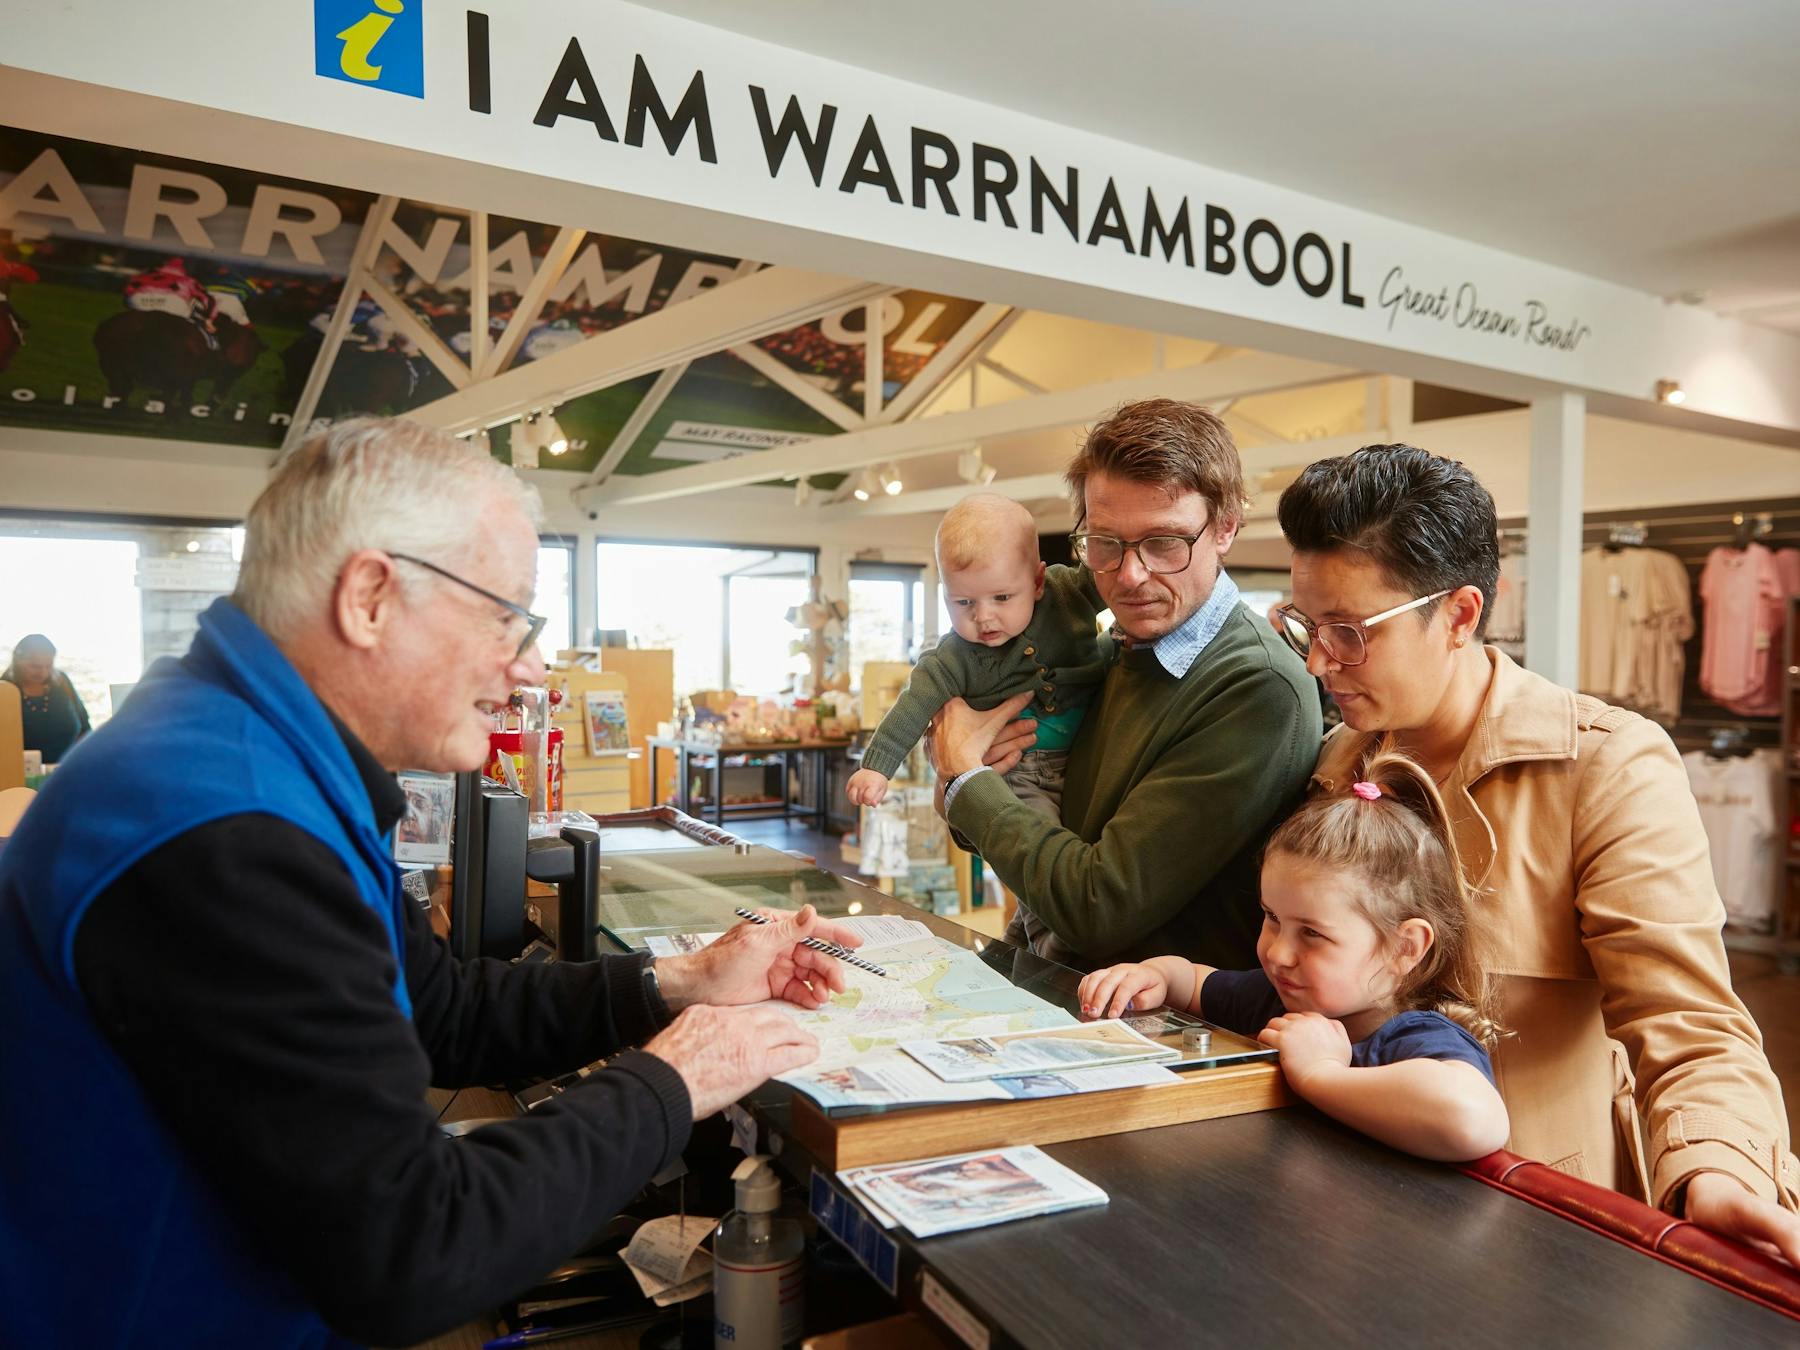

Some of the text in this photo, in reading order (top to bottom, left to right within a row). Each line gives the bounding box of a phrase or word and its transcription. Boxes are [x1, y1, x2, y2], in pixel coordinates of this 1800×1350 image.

[466, 9, 1366, 309] I AM WARRNAMBOOL
[1378, 266, 1592, 352] Great Ocean Road
